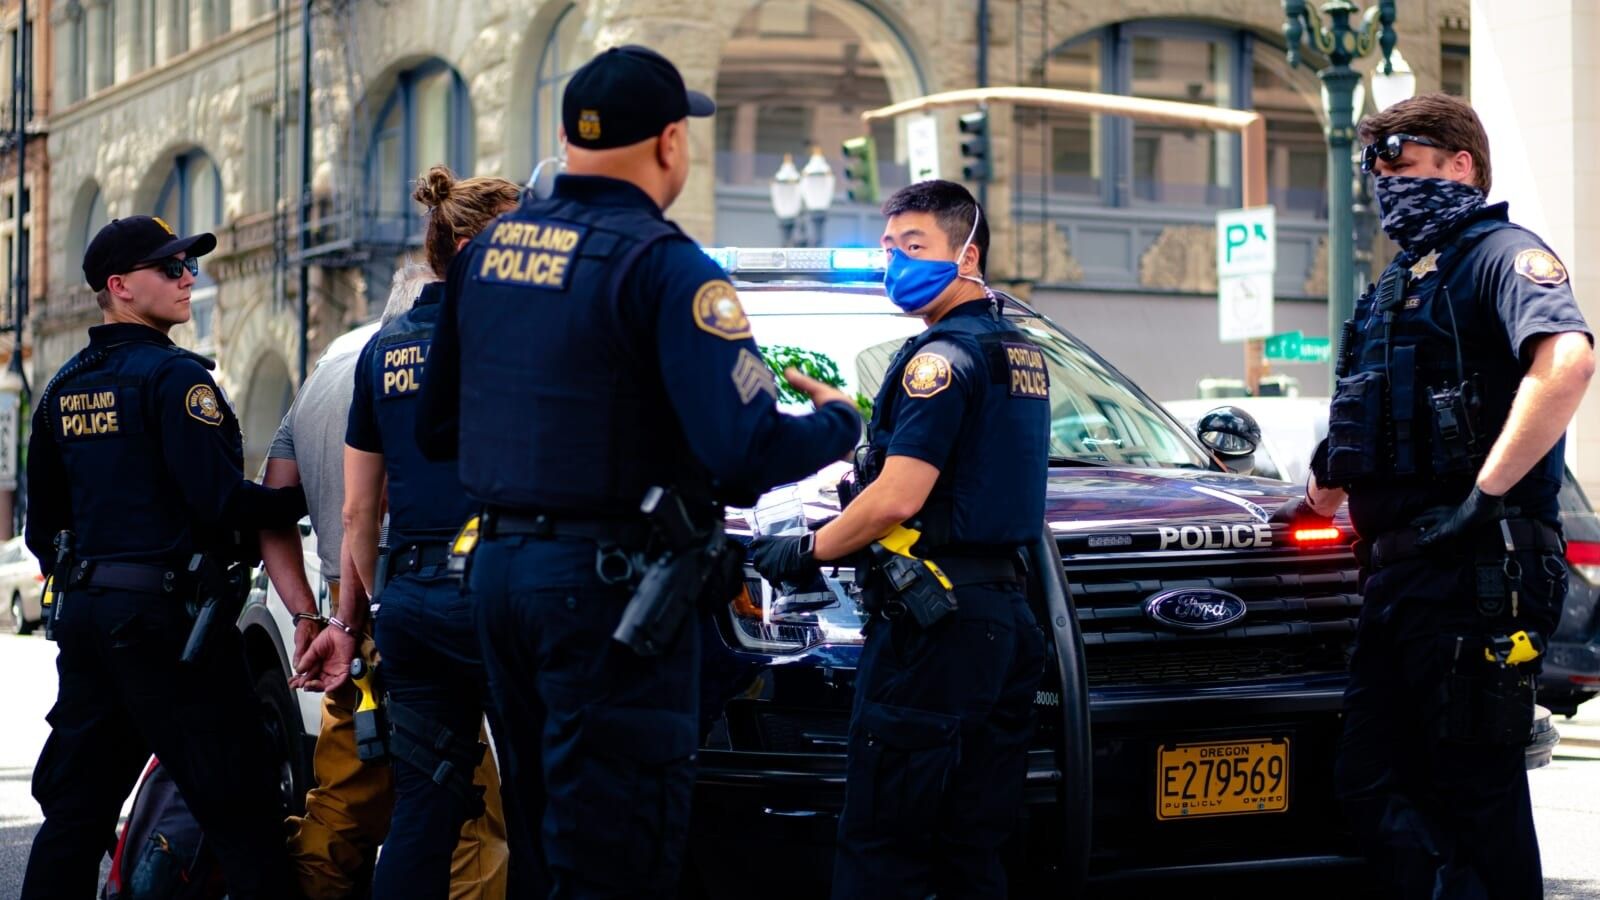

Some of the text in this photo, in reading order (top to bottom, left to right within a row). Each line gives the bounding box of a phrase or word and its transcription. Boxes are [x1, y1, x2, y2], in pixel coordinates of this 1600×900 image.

[490, 221, 579, 252] PORTLAND
[1227, 224, 1248, 264] P
[480, 248, 569, 286] POLICE
[385, 345, 426, 368] PORTL
[1007, 348, 1043, 369] PORTLAND
[384, 368, 420, 394] POL
[1012, 369, 1047, 396] POLICE
[60, 391, 115, 412] PORTLAND
[62, 412, 119, 437] POLICE
[1158, 524, 1273, 550] POLICE
[1175, 594, 1233, 621] Ford
[1033, 690, 1059, 706] 80004
[1200, 746, 1250, 758] OREGON
[1165, 755, 1283, 800] E279569
[1165, 795, 1283, 809] PUBLICLY OWNED
